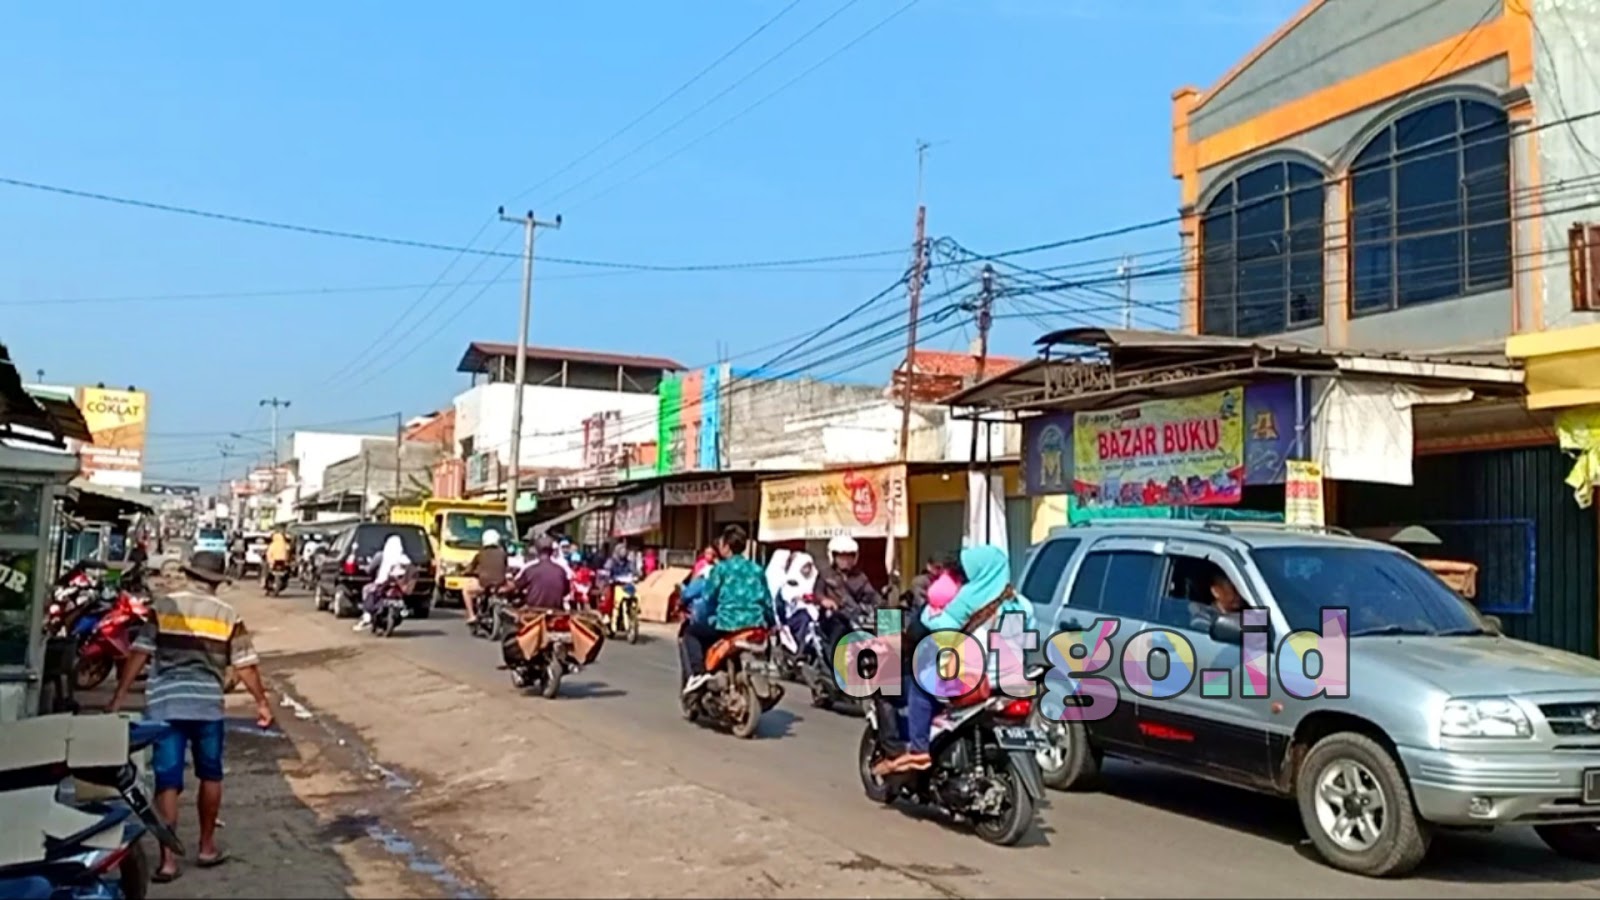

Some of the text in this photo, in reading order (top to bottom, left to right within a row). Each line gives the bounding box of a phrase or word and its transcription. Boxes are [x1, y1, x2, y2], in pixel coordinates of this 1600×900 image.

[87, 401, 140, 416] COKLAT
[1097, 418, 1220, 460] BAZAR BUKU
